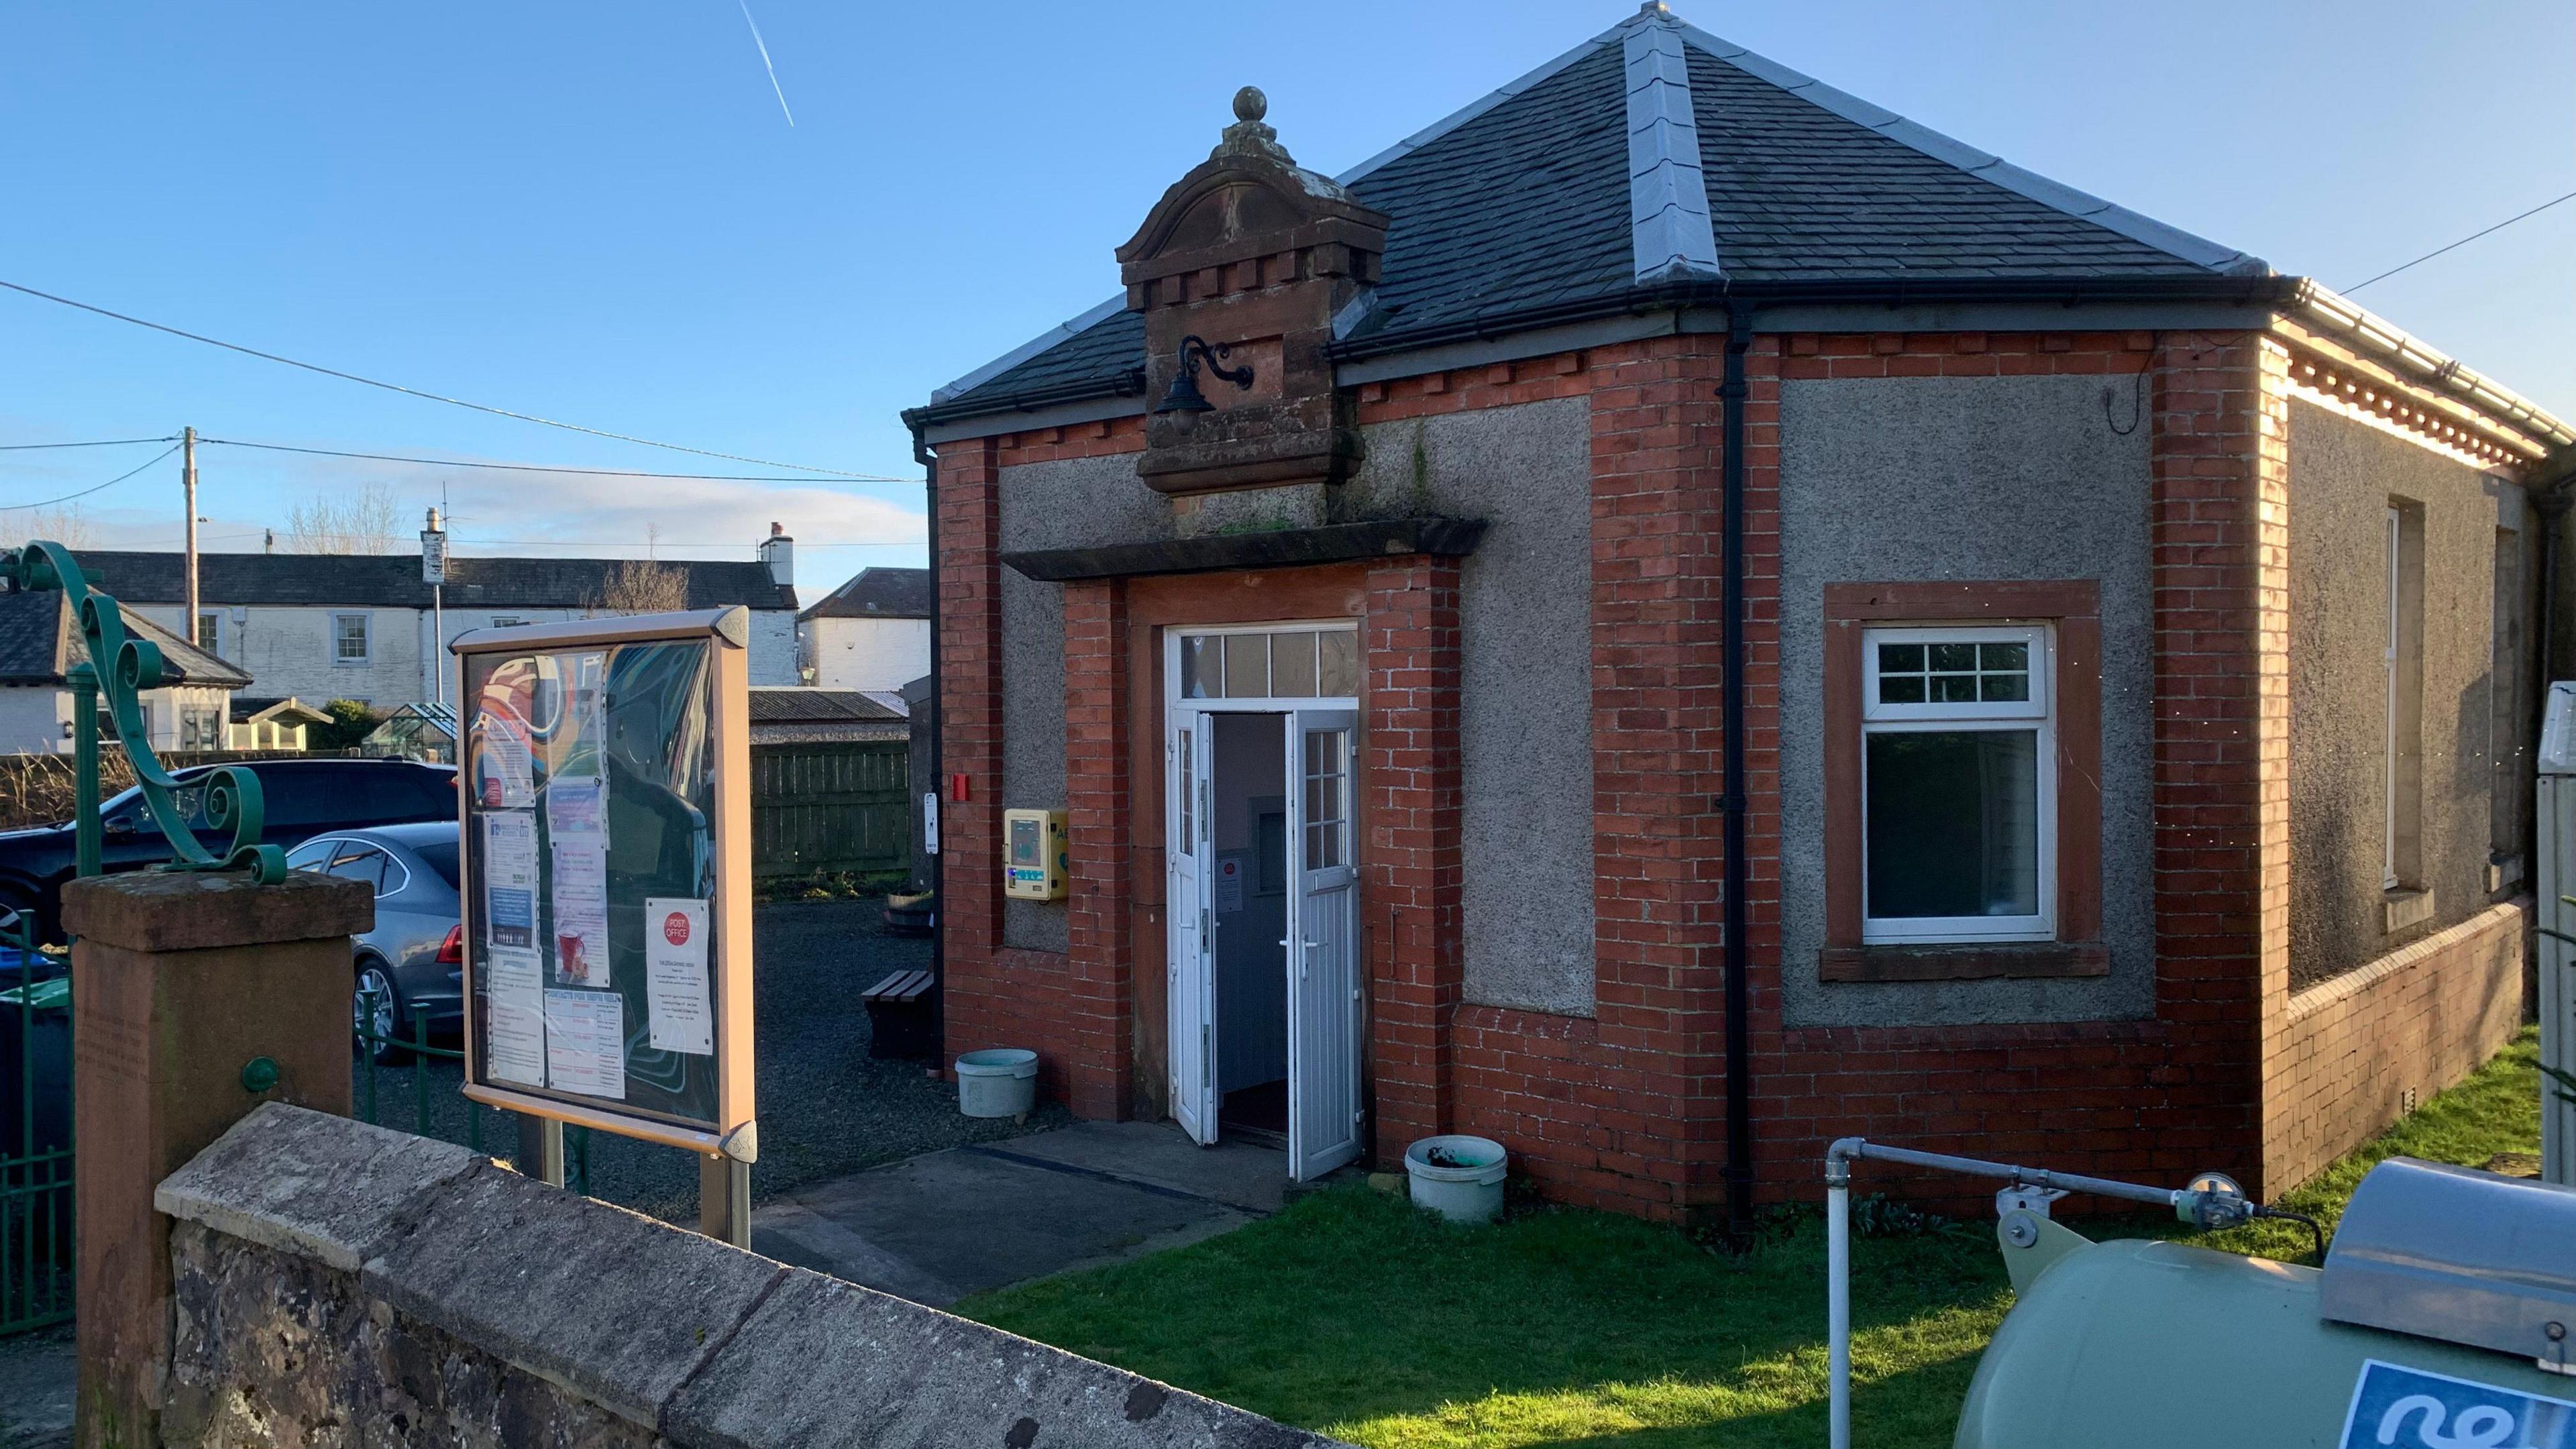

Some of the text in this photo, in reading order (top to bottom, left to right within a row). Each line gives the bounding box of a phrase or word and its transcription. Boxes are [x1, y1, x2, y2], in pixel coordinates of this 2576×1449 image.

[1057, 828, 1069, 839] AE
[669, 919, 685, 928] POST
[666, 928, 687, 937] OFFICE
